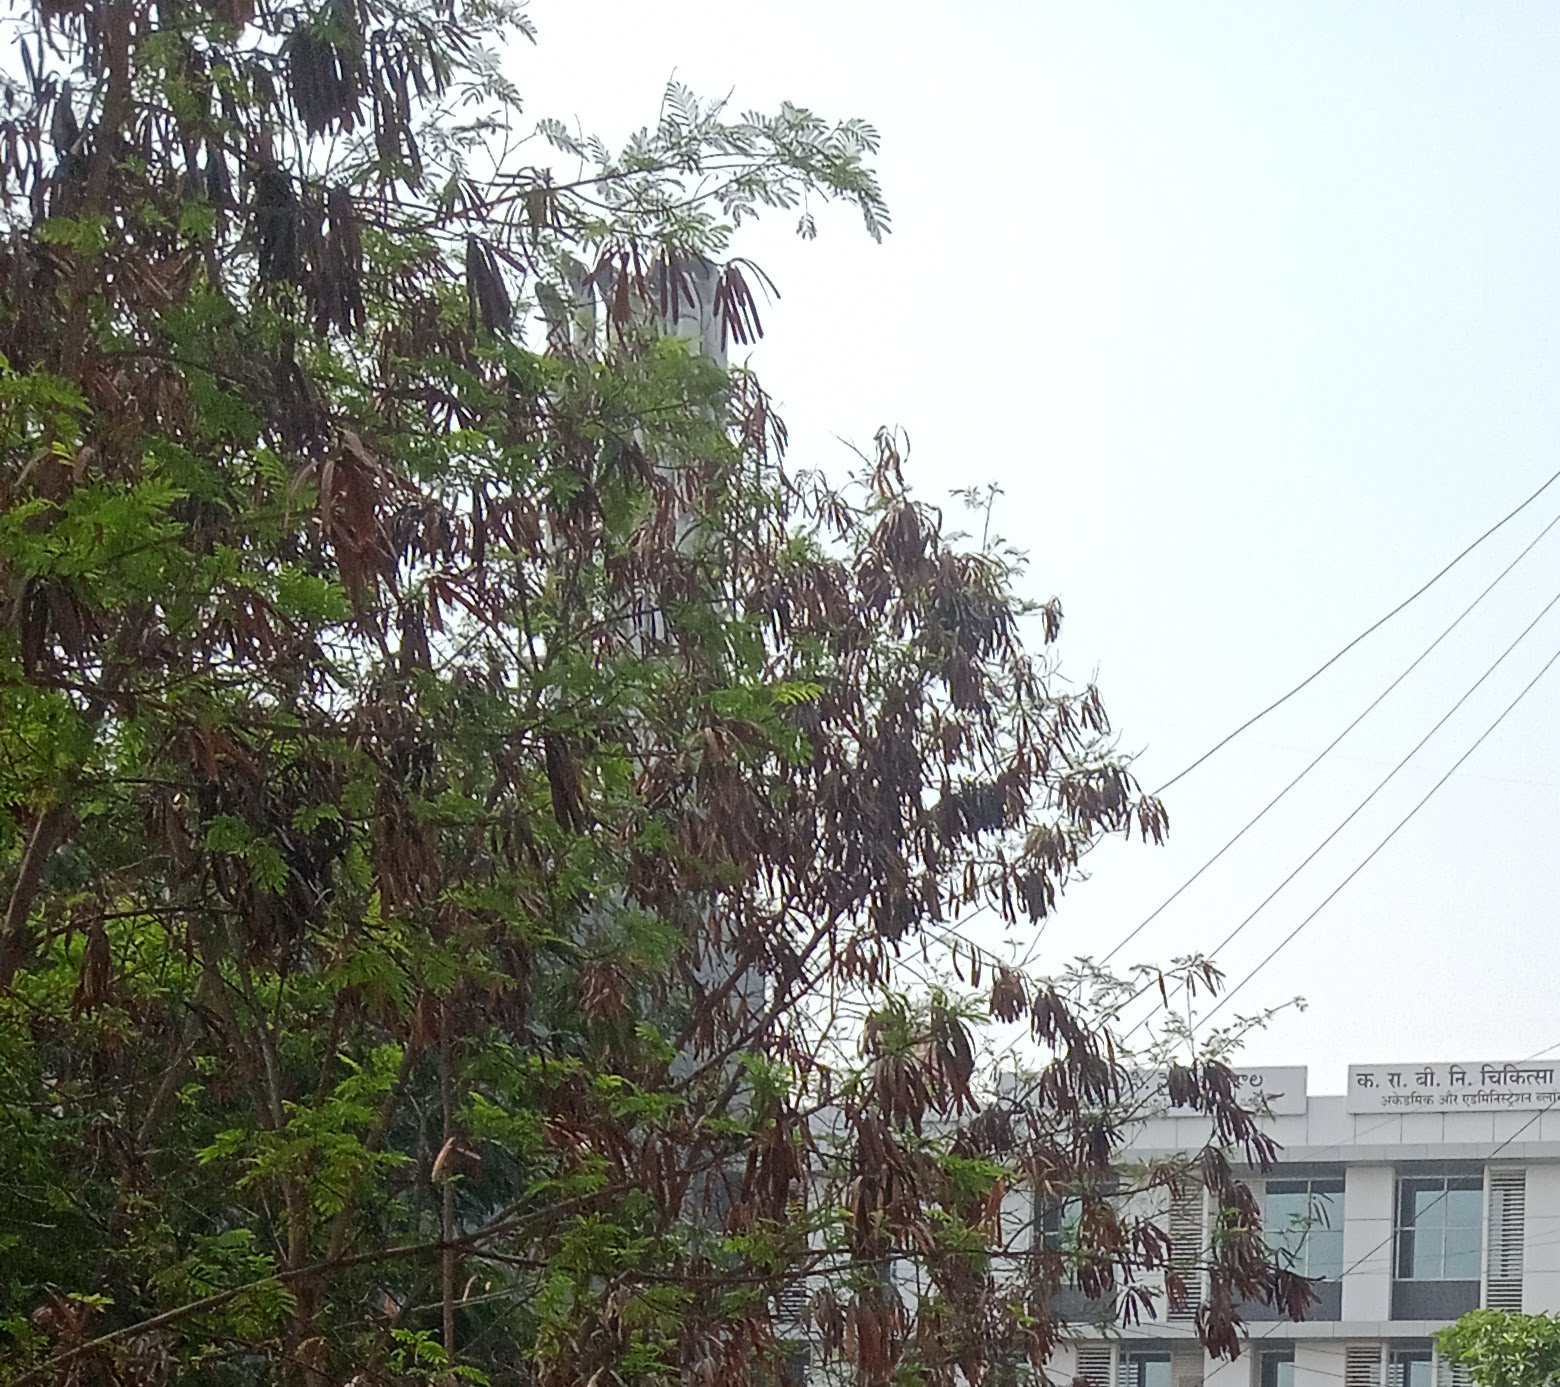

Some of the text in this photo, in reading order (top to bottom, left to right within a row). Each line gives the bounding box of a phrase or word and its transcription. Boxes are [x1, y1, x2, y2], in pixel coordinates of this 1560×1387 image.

[1356, 1072, 1379, 1088] क.
[1387, 1072, 1407, 1088] रा.
[1448, 1064, 1472, 1086] नि.
[1480, 1063, 1554, 1086] चिकित्सा
